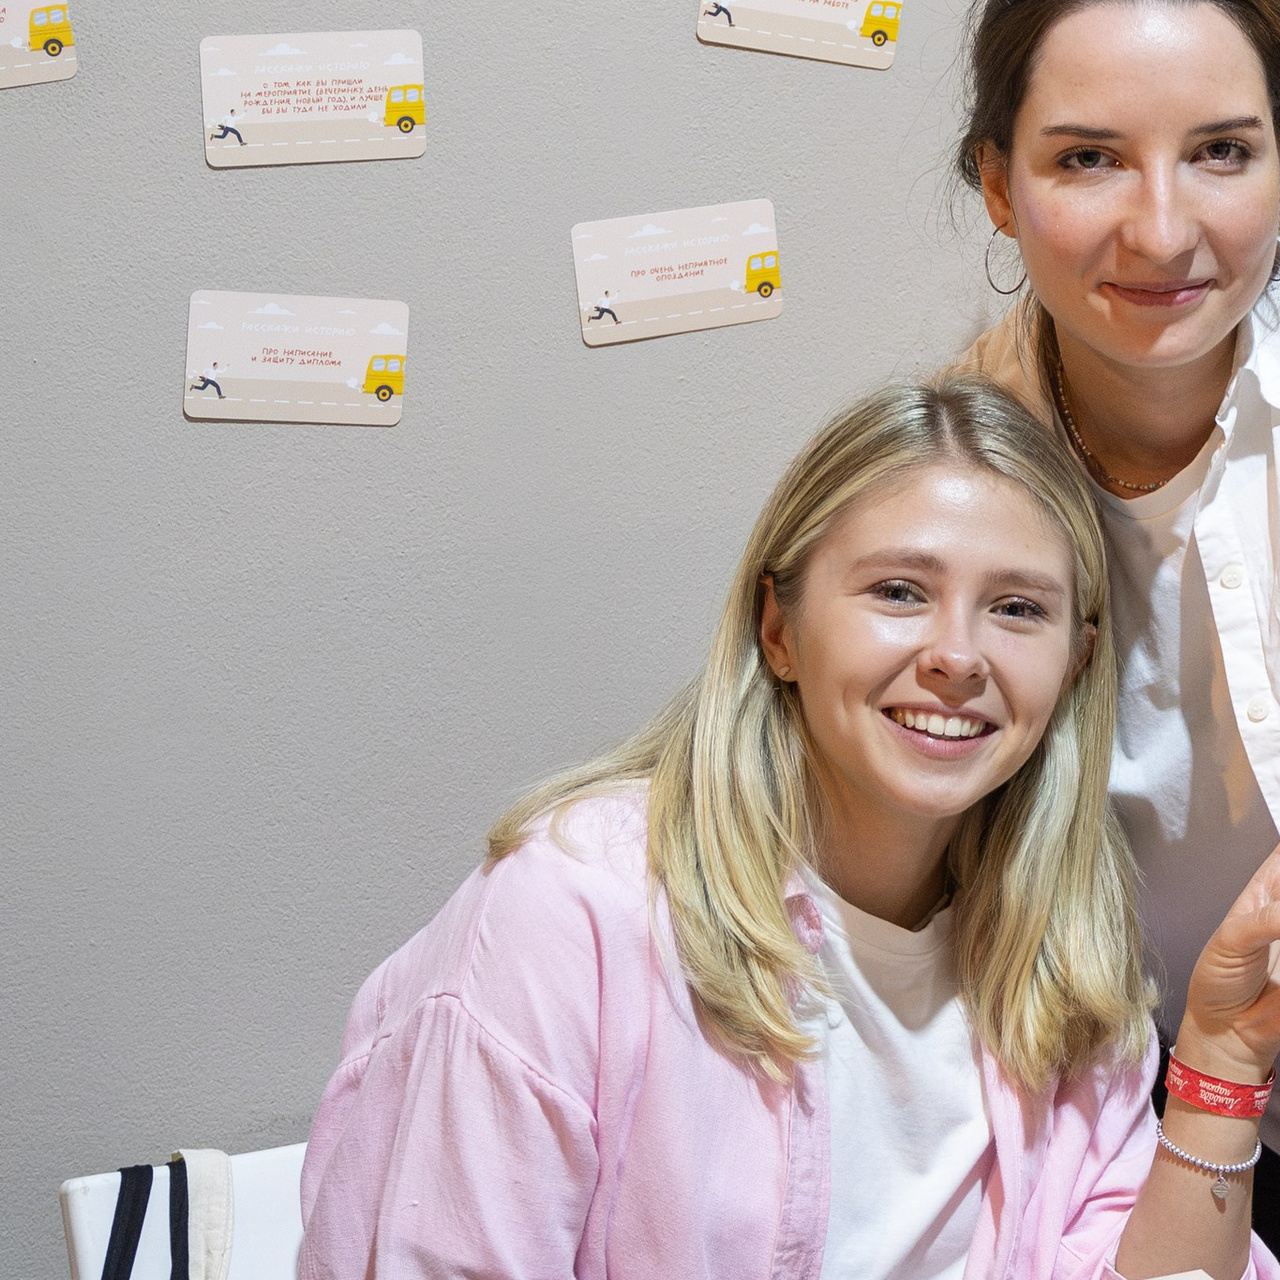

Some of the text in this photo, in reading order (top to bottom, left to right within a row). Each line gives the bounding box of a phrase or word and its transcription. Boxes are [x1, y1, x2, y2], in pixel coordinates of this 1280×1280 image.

[255, 88, 311, 97] МЕРОПРИЯТИЕ
[296, 96, 323, 104] НОВЫЙ
[631, 258, 727, 278] ПРО ОЧЕНЬ НЕПРИЯТНОЕ
[656, 270, 704, 282] ОПОЗДАНИЕ
[241, 322, 356, 336] РАССКАЖИ ИСТОРИЮ
[284, 349, 332, 358] НАПИСАНИЕ
[262, 356, 294, 365] ЗАЩИТУ
[299, 358, 341, 366] ДИПЛОМА
[1199, 1079, 1234, 1096] маркет
[1199, 1089, 1241, 1110] Ламбада
